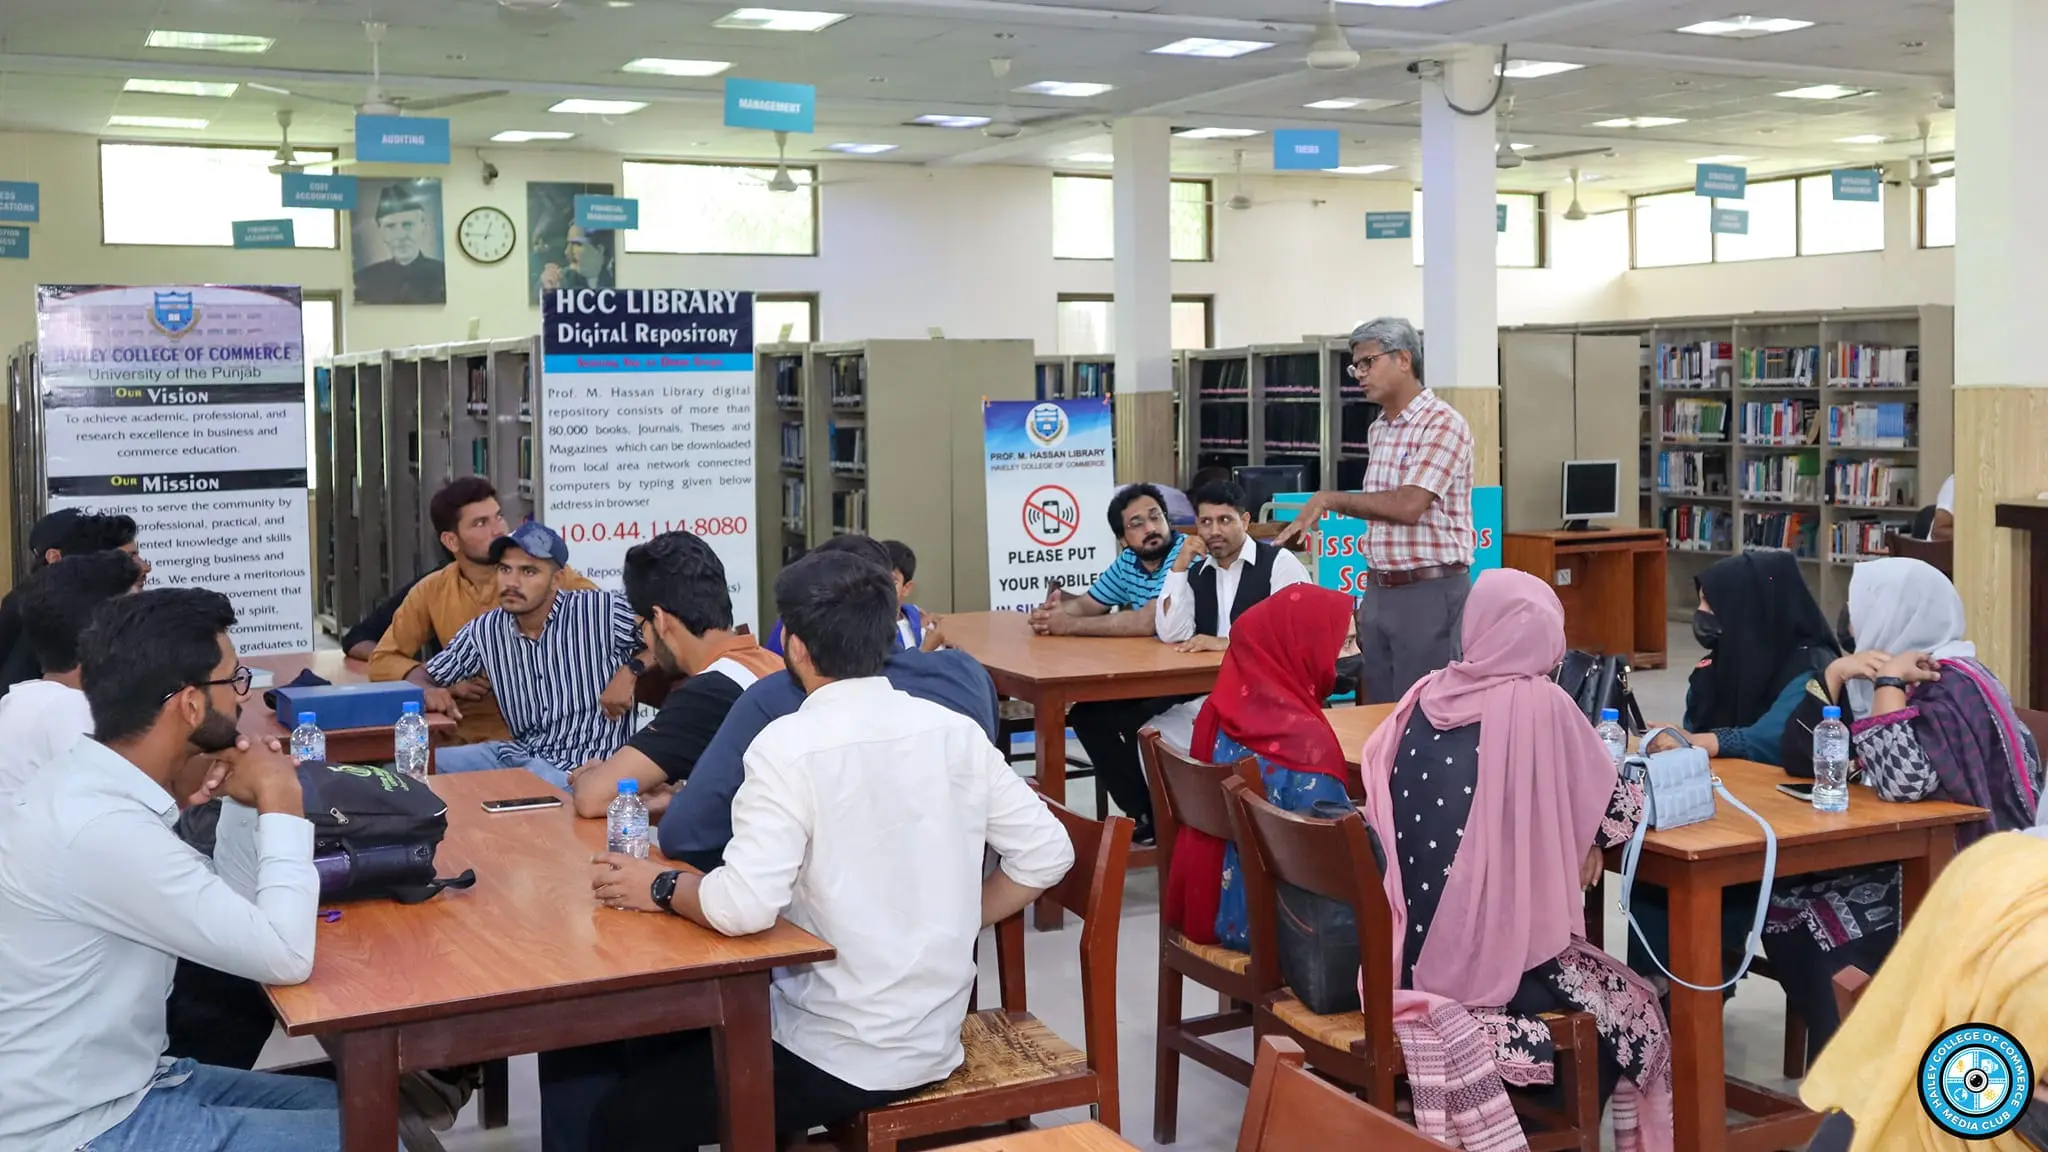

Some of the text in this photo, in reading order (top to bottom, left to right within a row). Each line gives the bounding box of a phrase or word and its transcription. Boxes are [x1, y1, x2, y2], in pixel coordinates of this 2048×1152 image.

[738, 97, 802, 114] MANAGEMENT
[381, 134, 425, 146] AUDITING
[556, 289, 740, 315] HCC LIBRARY
[112, 346, 180, 363] COLLEGE
[185, 346, 205, 362] OF
[209, 345, 291, 361] COMMERCE
[88, 366, 262, 382] University of the Punjab
[549, 386, 751, 399] Prof. M. Hassan Library digital
[66, 414, 79, 424] To
[82, 412, 128, 424] achieve
[192, 410, 263, 424] professional,
[266, 409, 287, 419] and
[549, 404, 751, 419] repository consists of more than
[76, 426, 278, 441] research excellence in business and
[690, 422, 726, 432] Theses
[732, 422, 751, 432] and
[117, 444, 241, 458] commerce education.
[549, 440, 751, 457] Magazines which can be downloaded
[990, 448, 1105, 462] PROF. M. HASSAN LIBRARY
[550, 457, 751, 473] from local area network connected
[1021, 462, 1052, 471] COLLEGE
[1056, 461, 1064, 469] OF
[1066, 460, 1105, 469] COMMERCE
[550, 475, 752, 493] computers by typing given below
[141, 503, 154, 513] to
[157, 504, 188, 513] serve
[191, 501, 210, 511] the
[212, 498, 275, 511] community
[279, 498, 293, 510] by
[549, 497, 650, 511] address in browser
[136, 515, 285, 534] professional, practical, and
[136, 532, 292, 550] iented knowledge and skills
[155, 554, 212, 568] emerging
[214, 553, 261, 564] business
[264, 551, 285, 561] and
[1008, 546, 1096, 565] PLEASE PUT
[168, 575, 188, 585] We
[191, 572, 231, 583] endure
[233, 573, 241, 581] a
[243, 568, 306, 579] meritorious
[999, 572, 1103, 592] YOUR MOBILE
[224, 586, 302, 598] rovement that
[239, 638, 308, 654] graduates to
